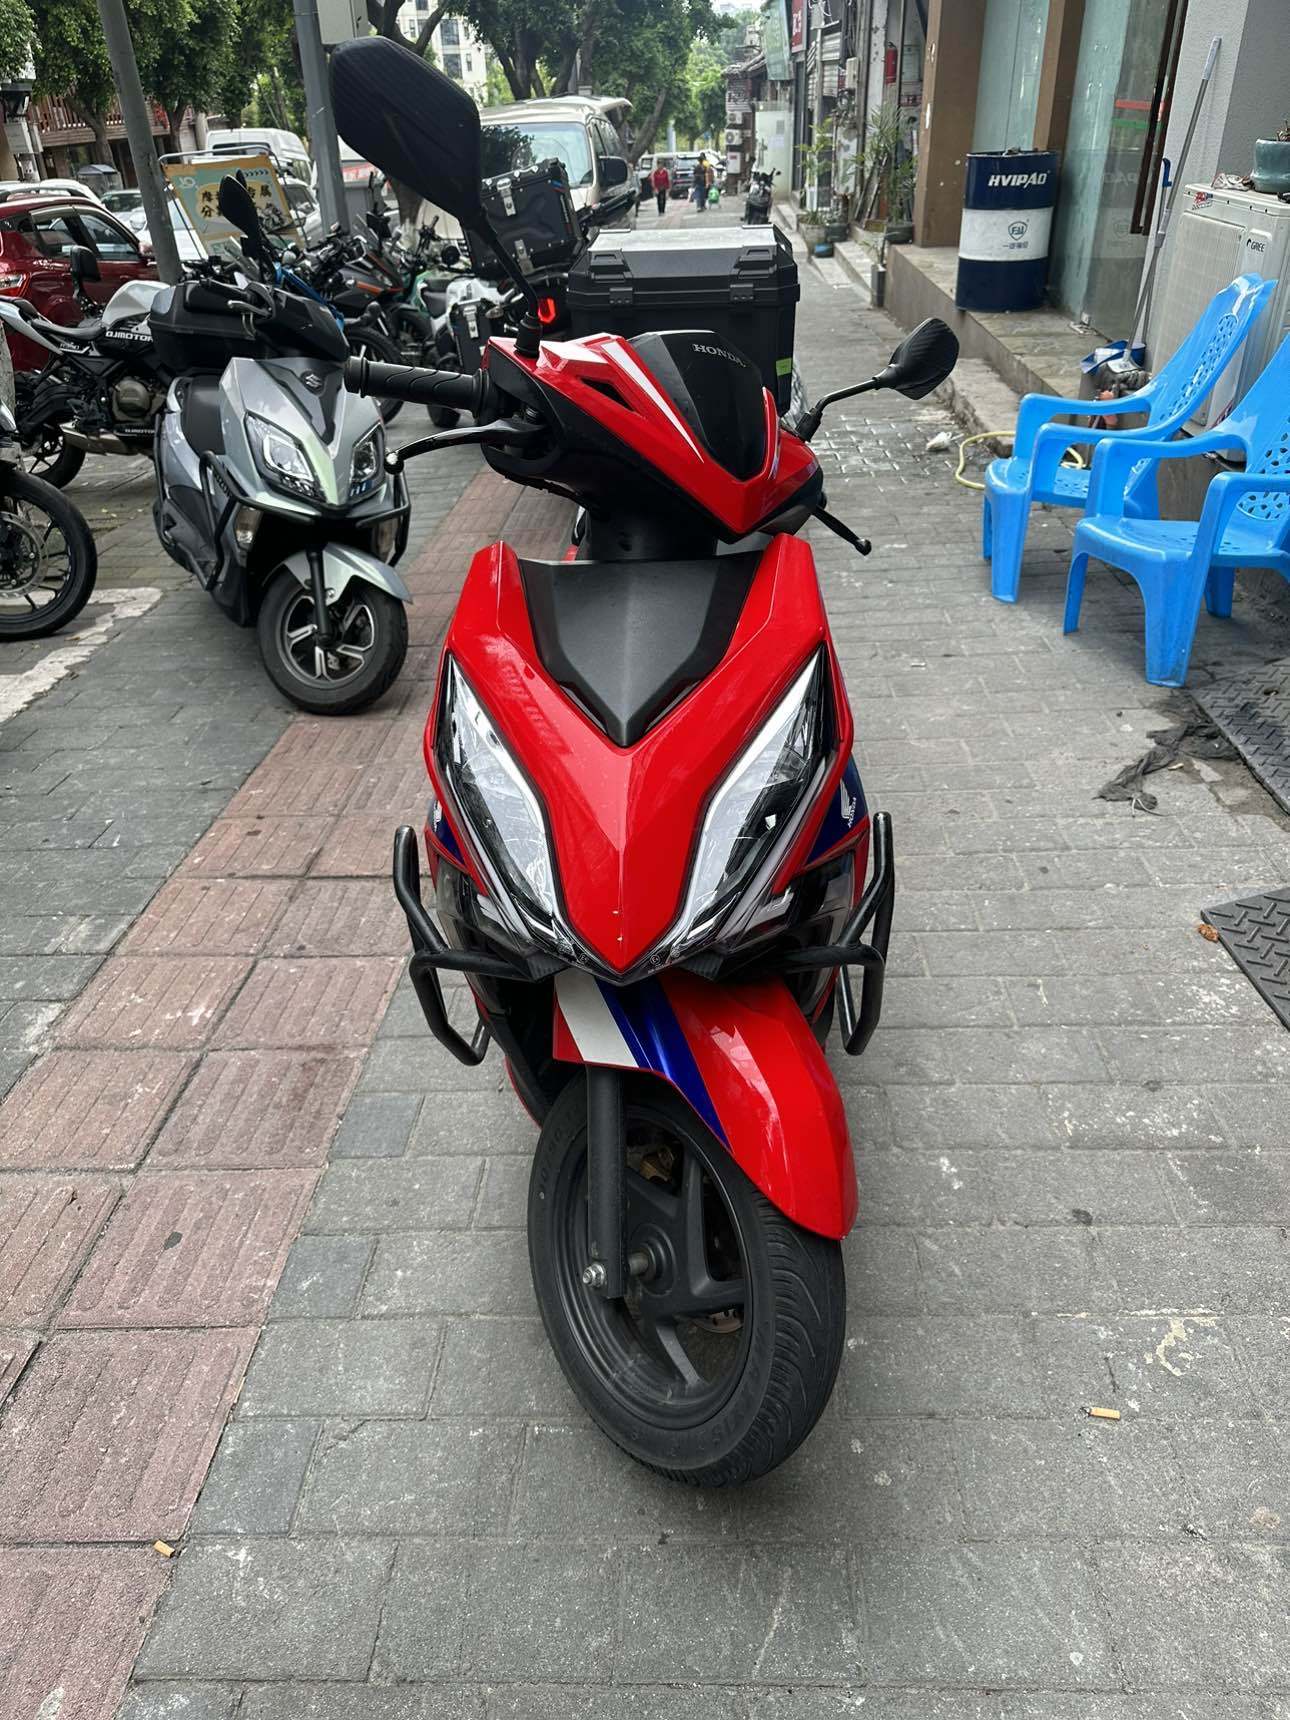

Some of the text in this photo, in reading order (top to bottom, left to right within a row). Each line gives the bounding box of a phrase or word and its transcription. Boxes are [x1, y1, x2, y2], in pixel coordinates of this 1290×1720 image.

[988, 172, 1048, 189] HVIPAO
[1251, 241, 1265, 253] GREE
[692, 344, 746, 367] HONDA
